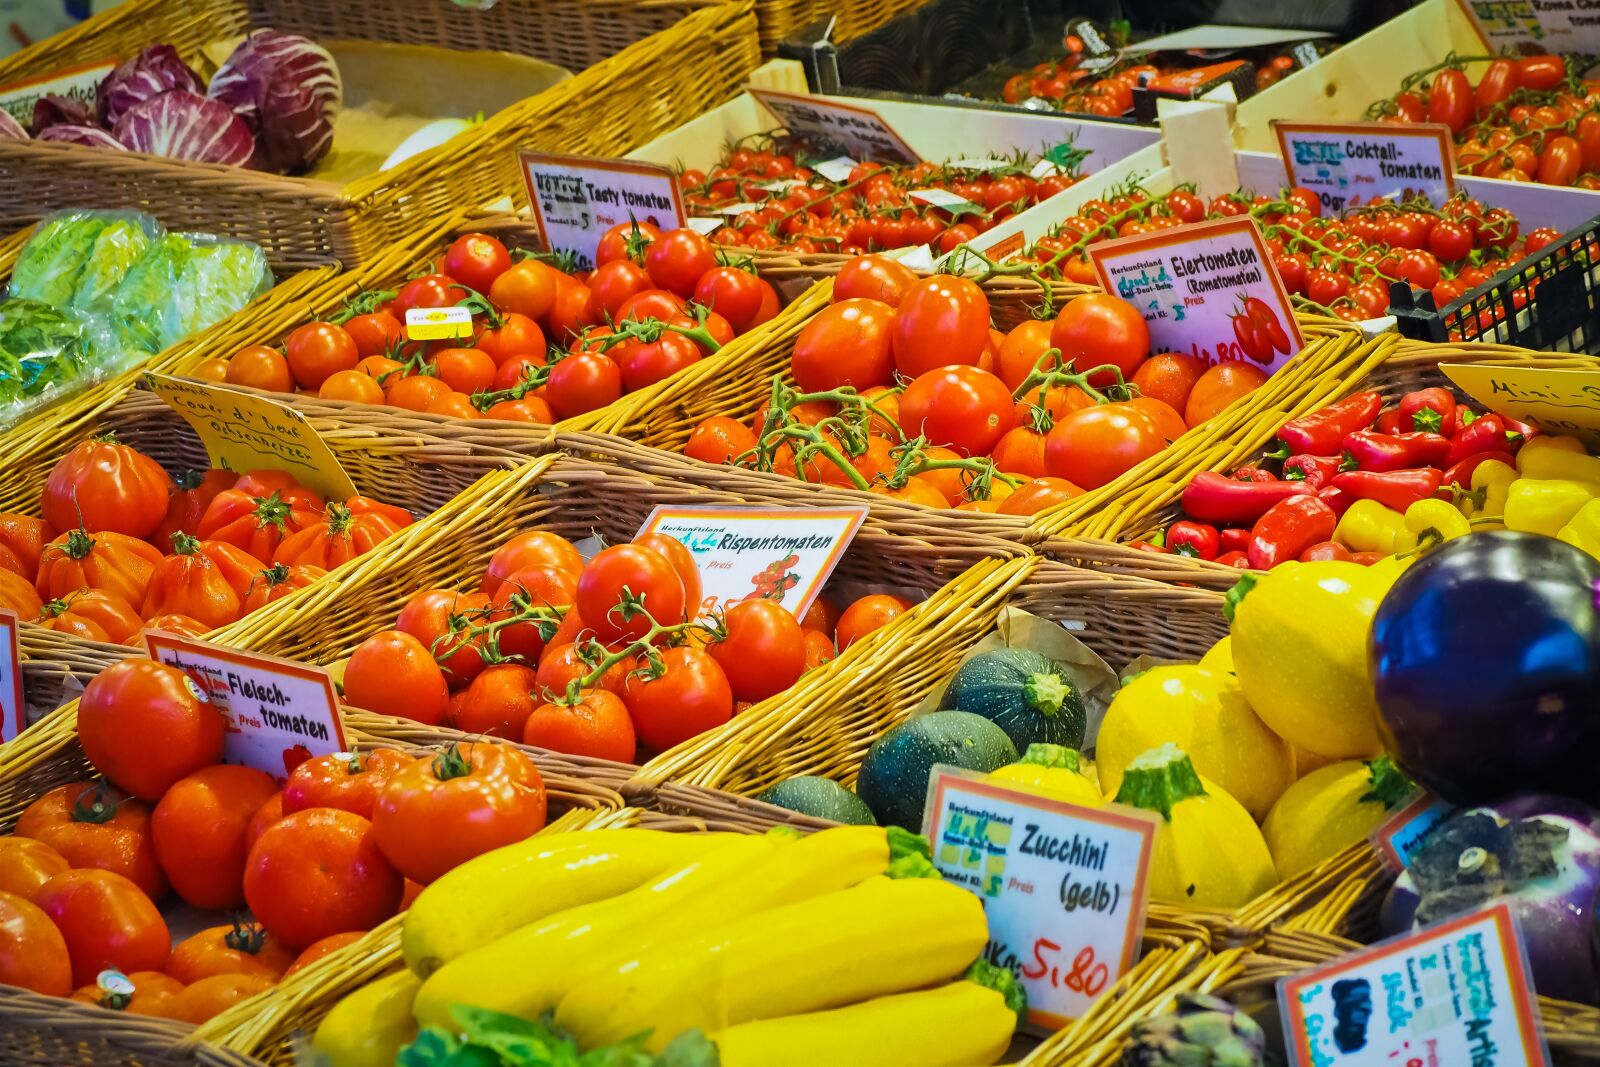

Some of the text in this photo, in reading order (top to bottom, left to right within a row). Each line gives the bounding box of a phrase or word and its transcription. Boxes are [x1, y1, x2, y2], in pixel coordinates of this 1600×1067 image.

[1379, 160, 1442, 180] tomaten
[586, 183, 620, 207] Tasty
[621, 189, 672, 211] tomaten
[1110, 258, 1163, 275] Herkunftsland
[1171, 246, 1257, 278] Eiertomaten
[1187, 266, 1262, 295] (Romatomaten)
[661, 525, 726, 533] Herkunftsland
[717, 533, 834, 555] Rispentomaten
[227, 672, 291, 707] Fleisch-
[260, 704, 329, 741] tomaten
[949, 801, 1014, 826] Herkunftsland
[1019, 824, 1109, 871] Zucchini
[1059, 872, 1121, 916] (gelb)
